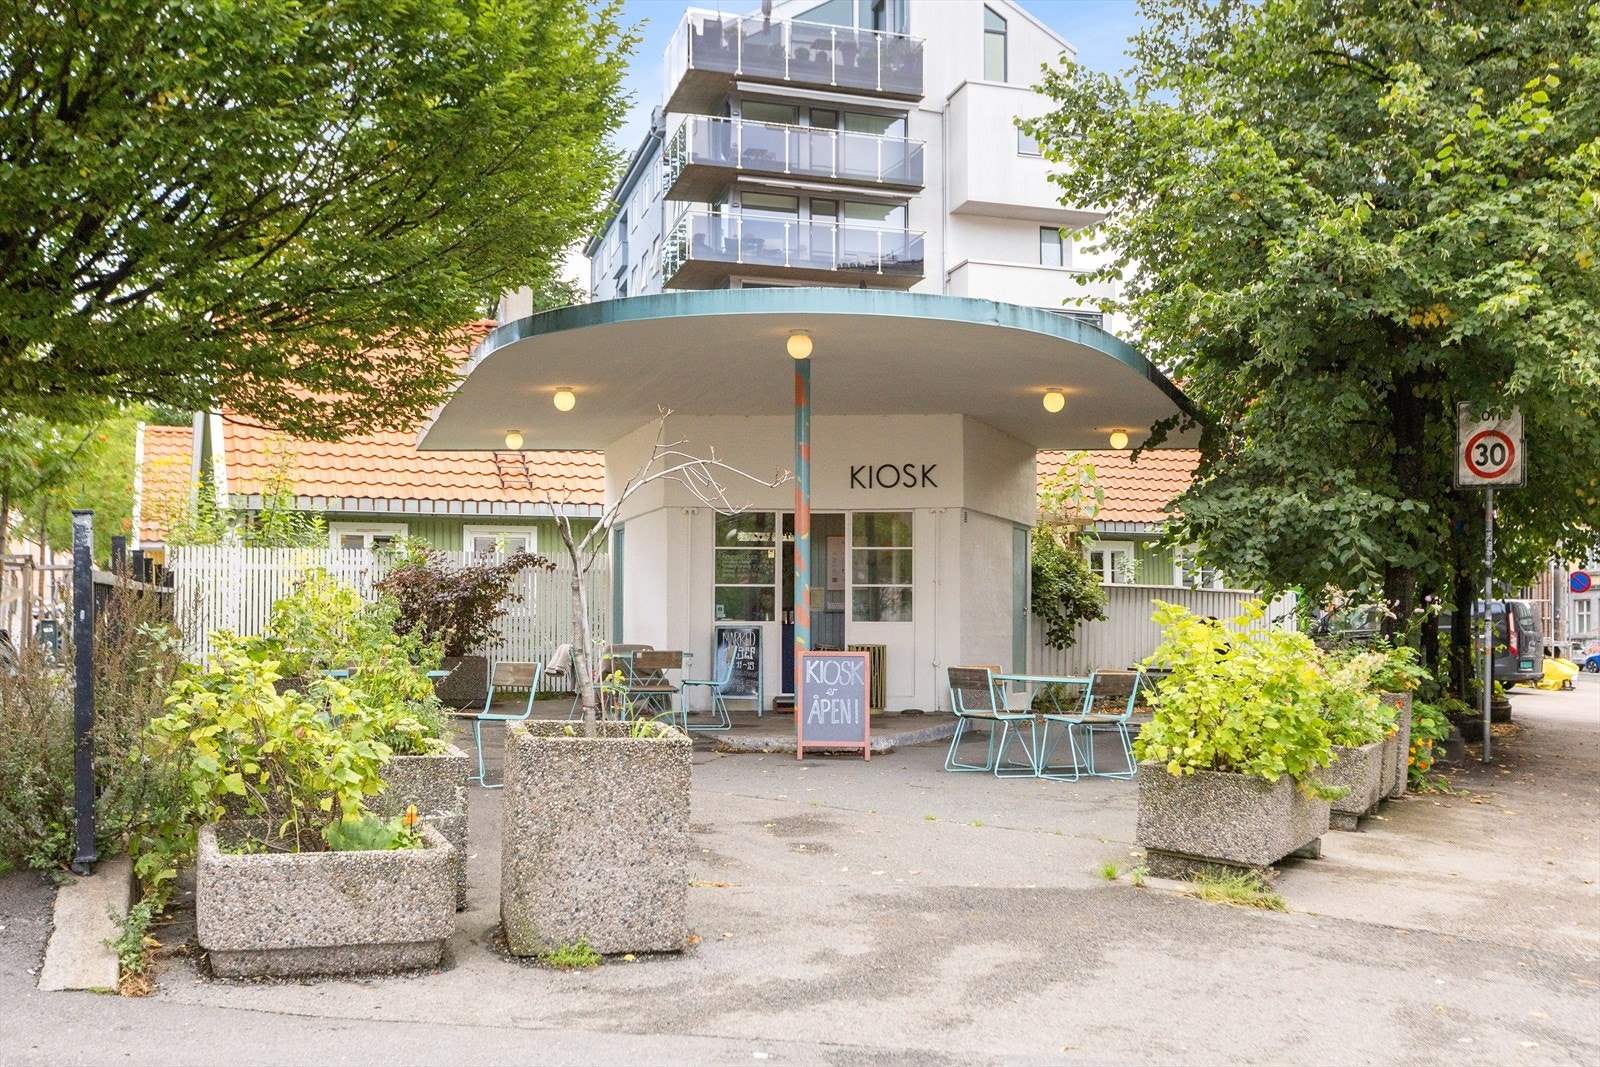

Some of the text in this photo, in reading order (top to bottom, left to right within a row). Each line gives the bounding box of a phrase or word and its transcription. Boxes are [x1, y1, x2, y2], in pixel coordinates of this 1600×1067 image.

[1475, 443, 1506, 467] 30
[850, 463, 938, 489] KIOSK
[806, 660, 865, 686] KIOSK
[826, 688, 838, 696] er
[807, 695, 859, 724] ÅPEN!
